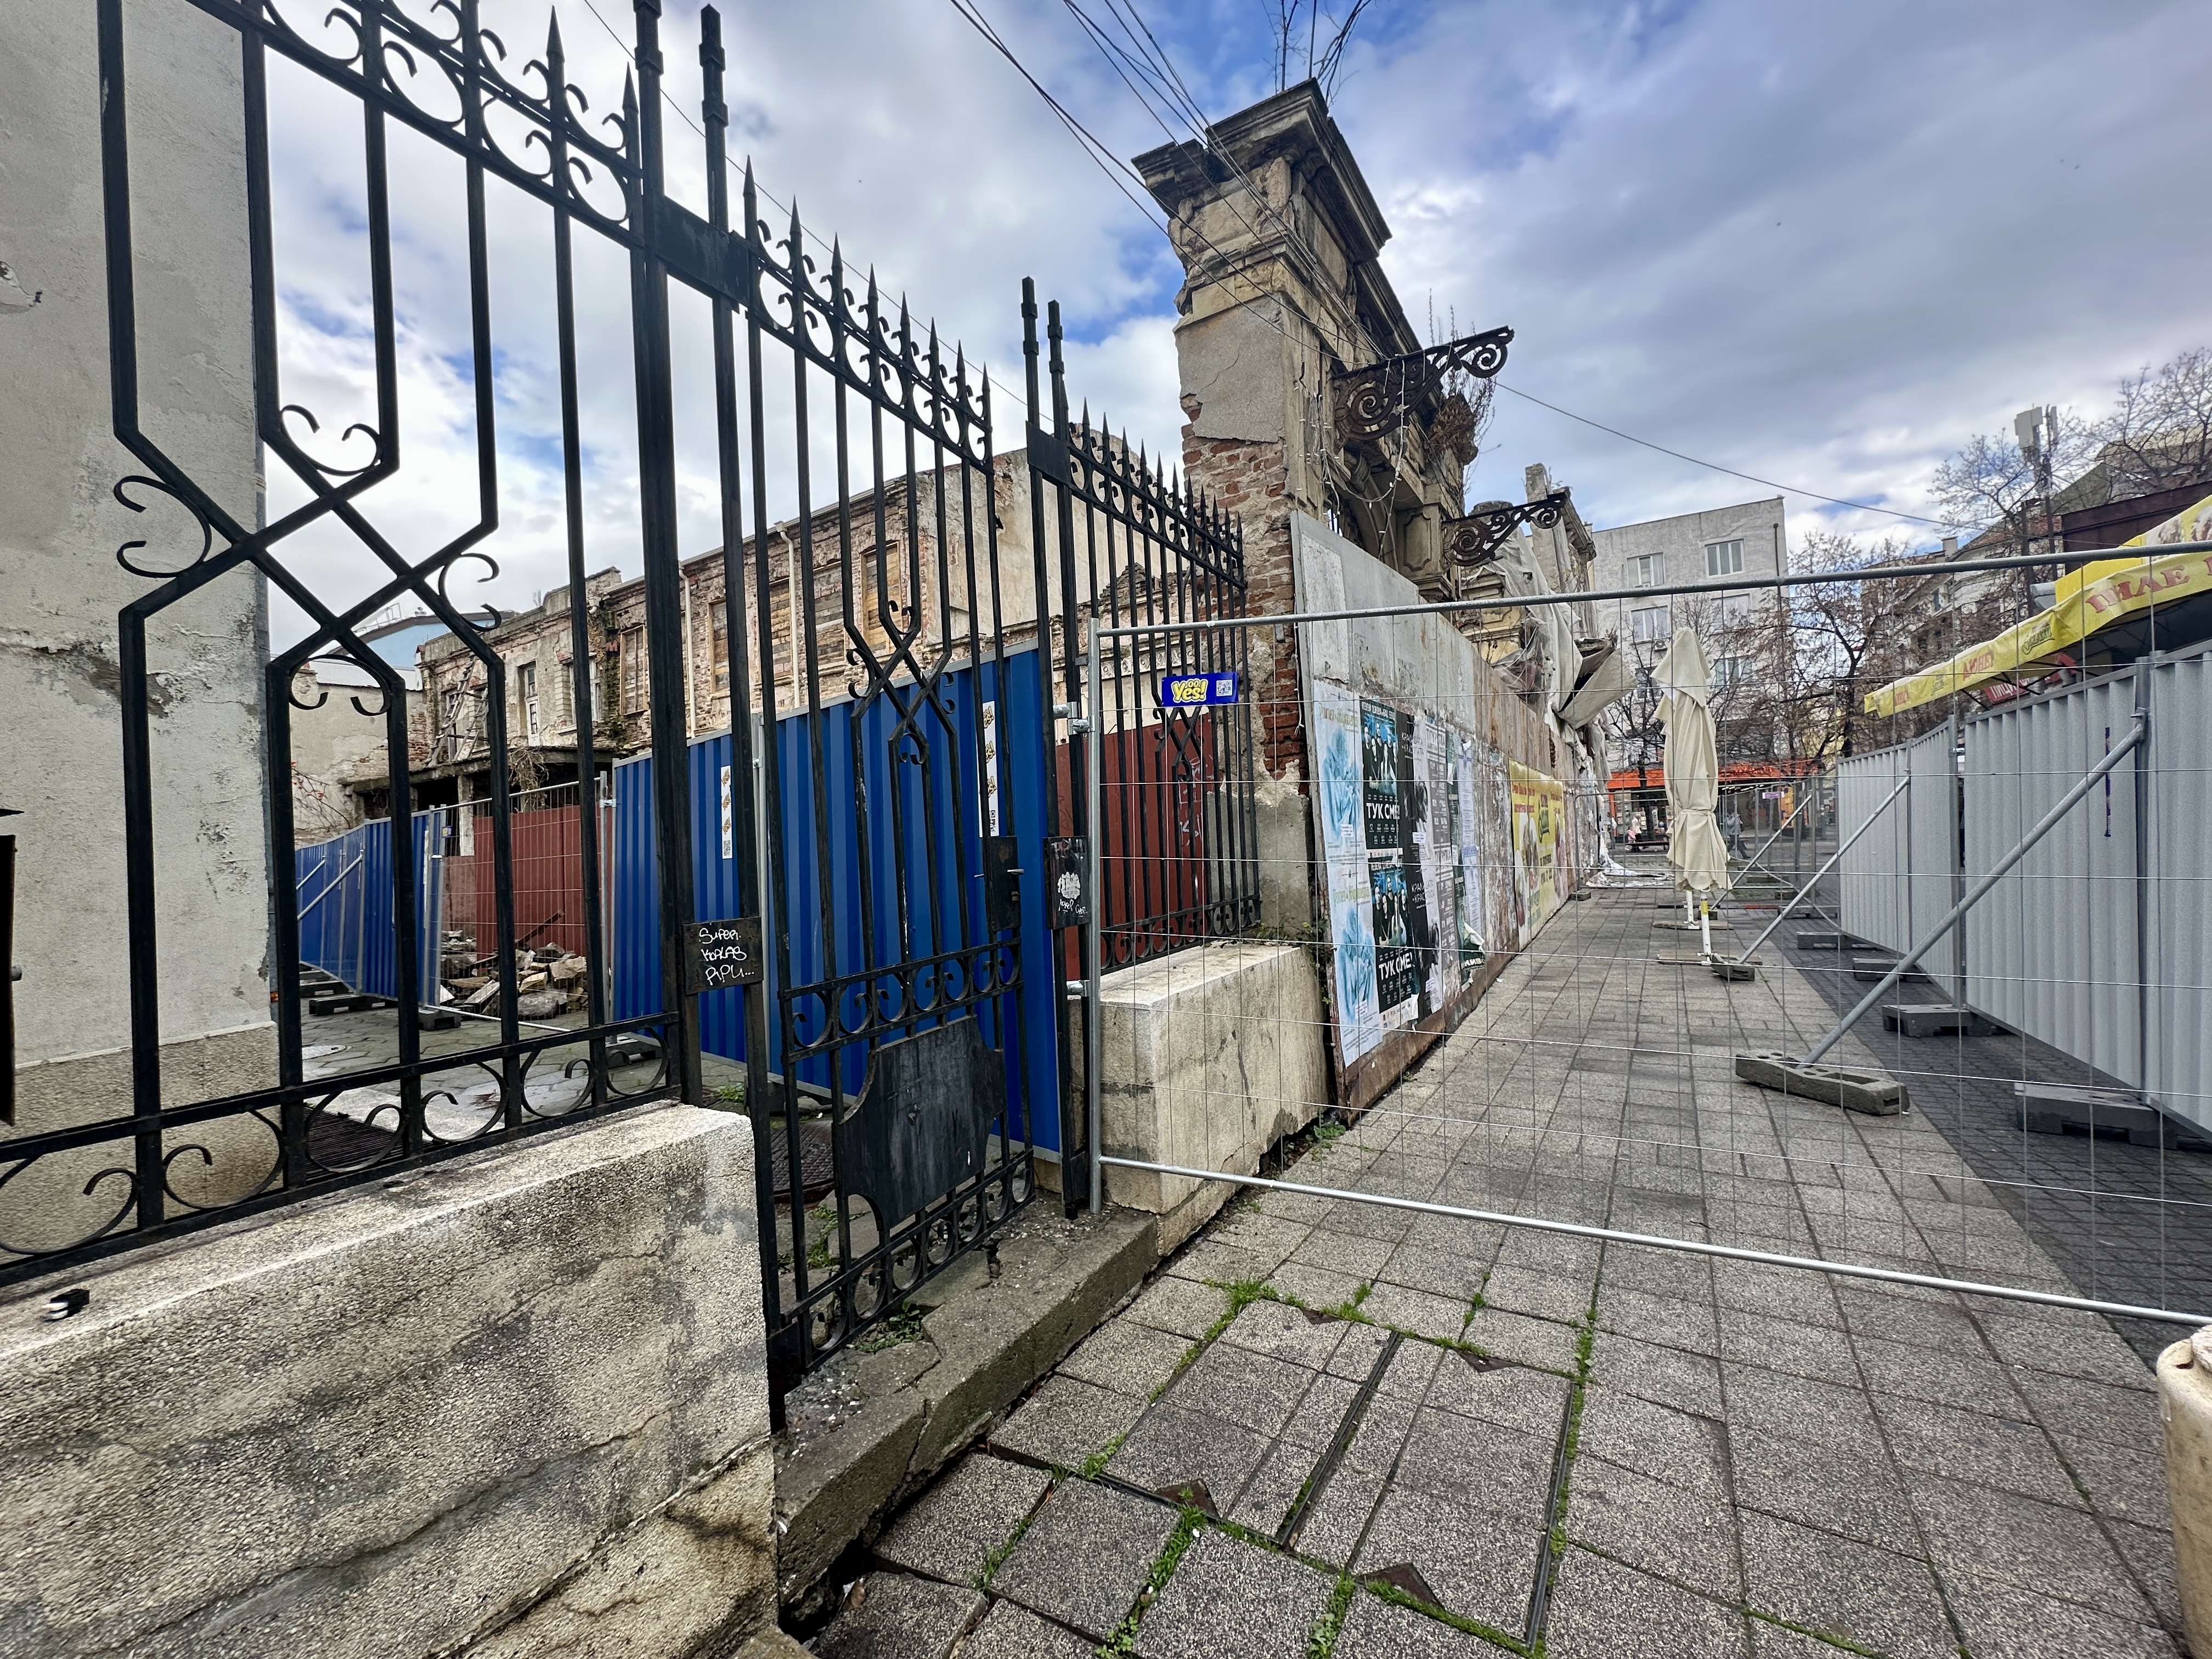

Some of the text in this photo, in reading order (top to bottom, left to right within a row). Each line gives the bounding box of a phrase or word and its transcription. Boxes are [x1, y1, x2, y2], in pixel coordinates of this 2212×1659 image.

[1172, 679, 1208, 703] Yes!
[1366, 803, 1384, 819] ТУК
[1379, 959, 1396, 980] ТУК
[1396, 952, 1413, 973] СМЕ!
